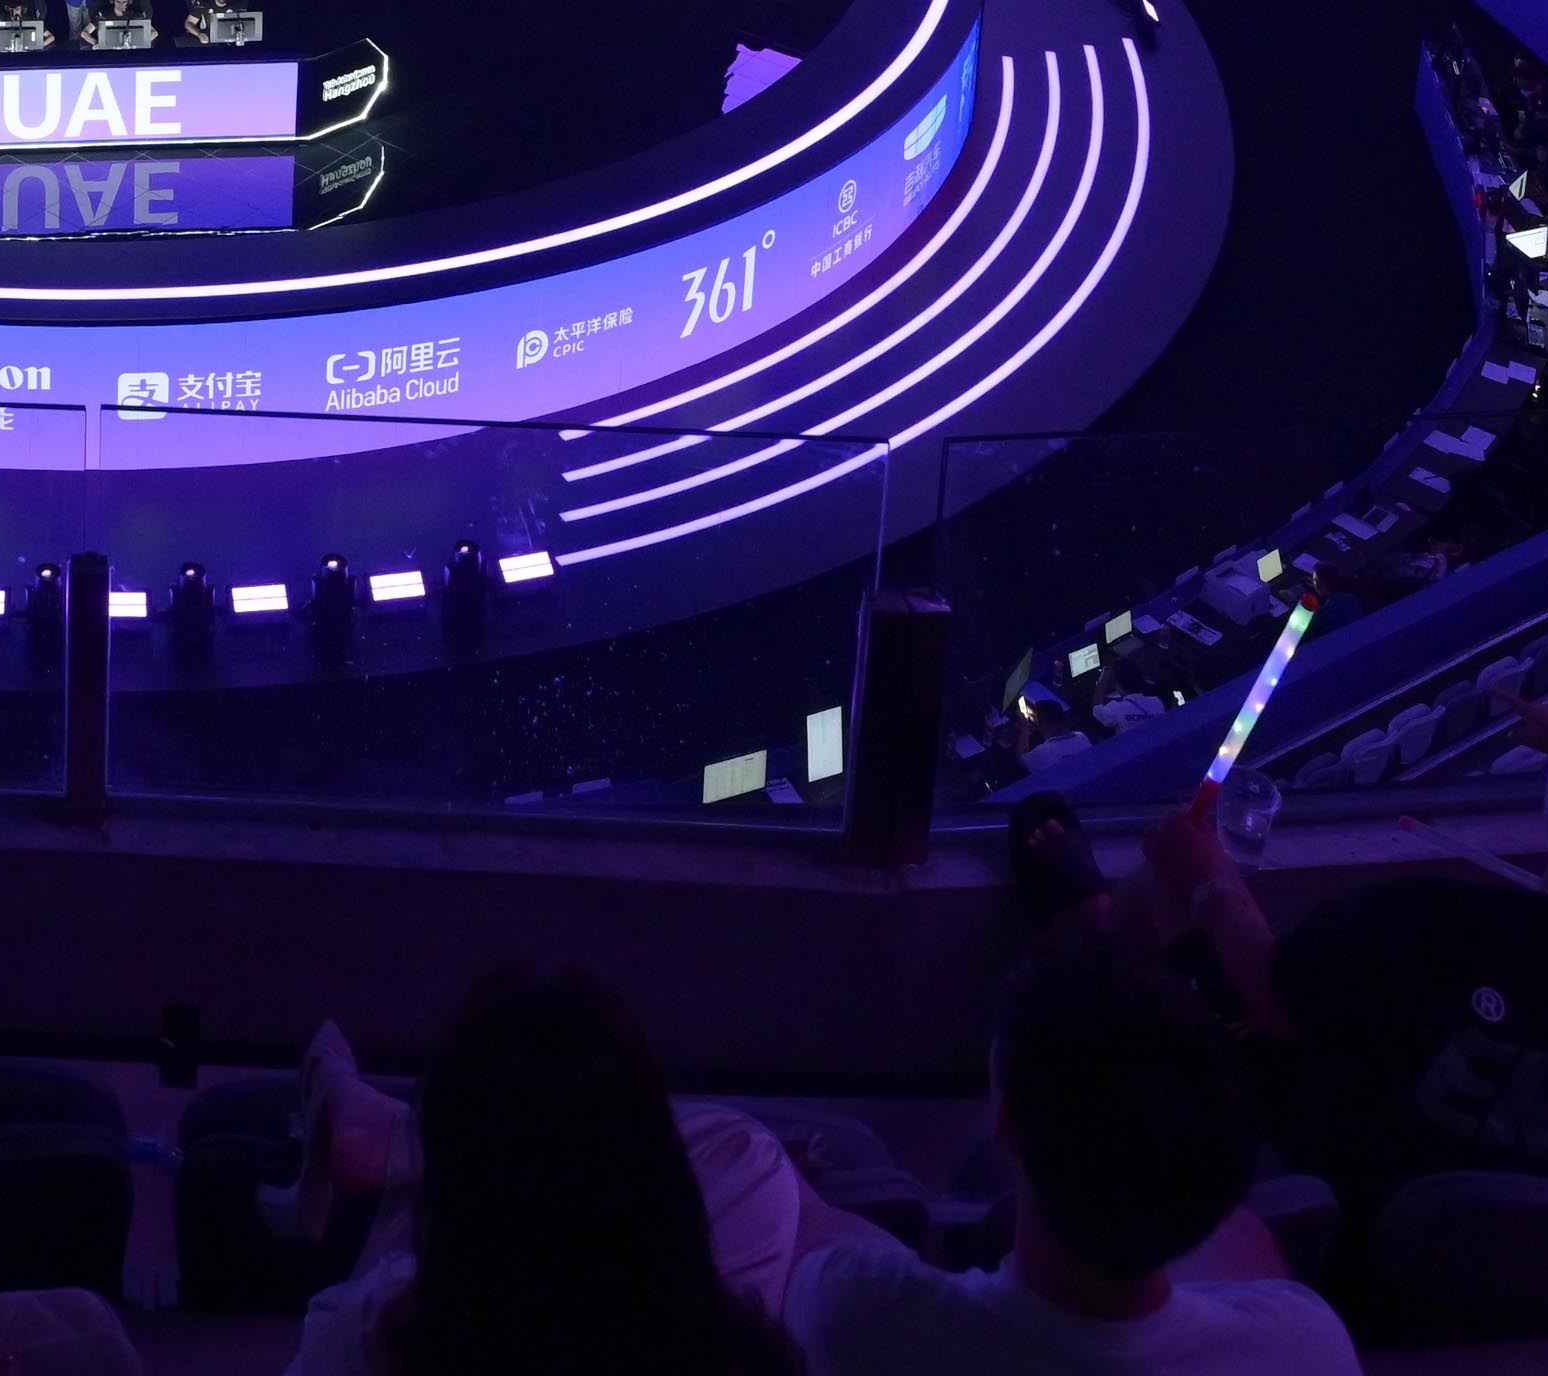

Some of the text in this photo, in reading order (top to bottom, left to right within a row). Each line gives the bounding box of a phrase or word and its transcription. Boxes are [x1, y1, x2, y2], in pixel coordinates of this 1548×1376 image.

[3, 69, 182, 140] UAE
[832, 209, 858, 238] ICBC
[810, 224, 873, 278] 中国工商银行
[553, 307, 633, 344] 太平洋保险
[381, 337, 460, 377] 阿里云
[553, 340, 585, 358] CPIC
[177, 370, 262, 401] 支付宝
[325, 371, 460, 412] Alibaba Cloud
